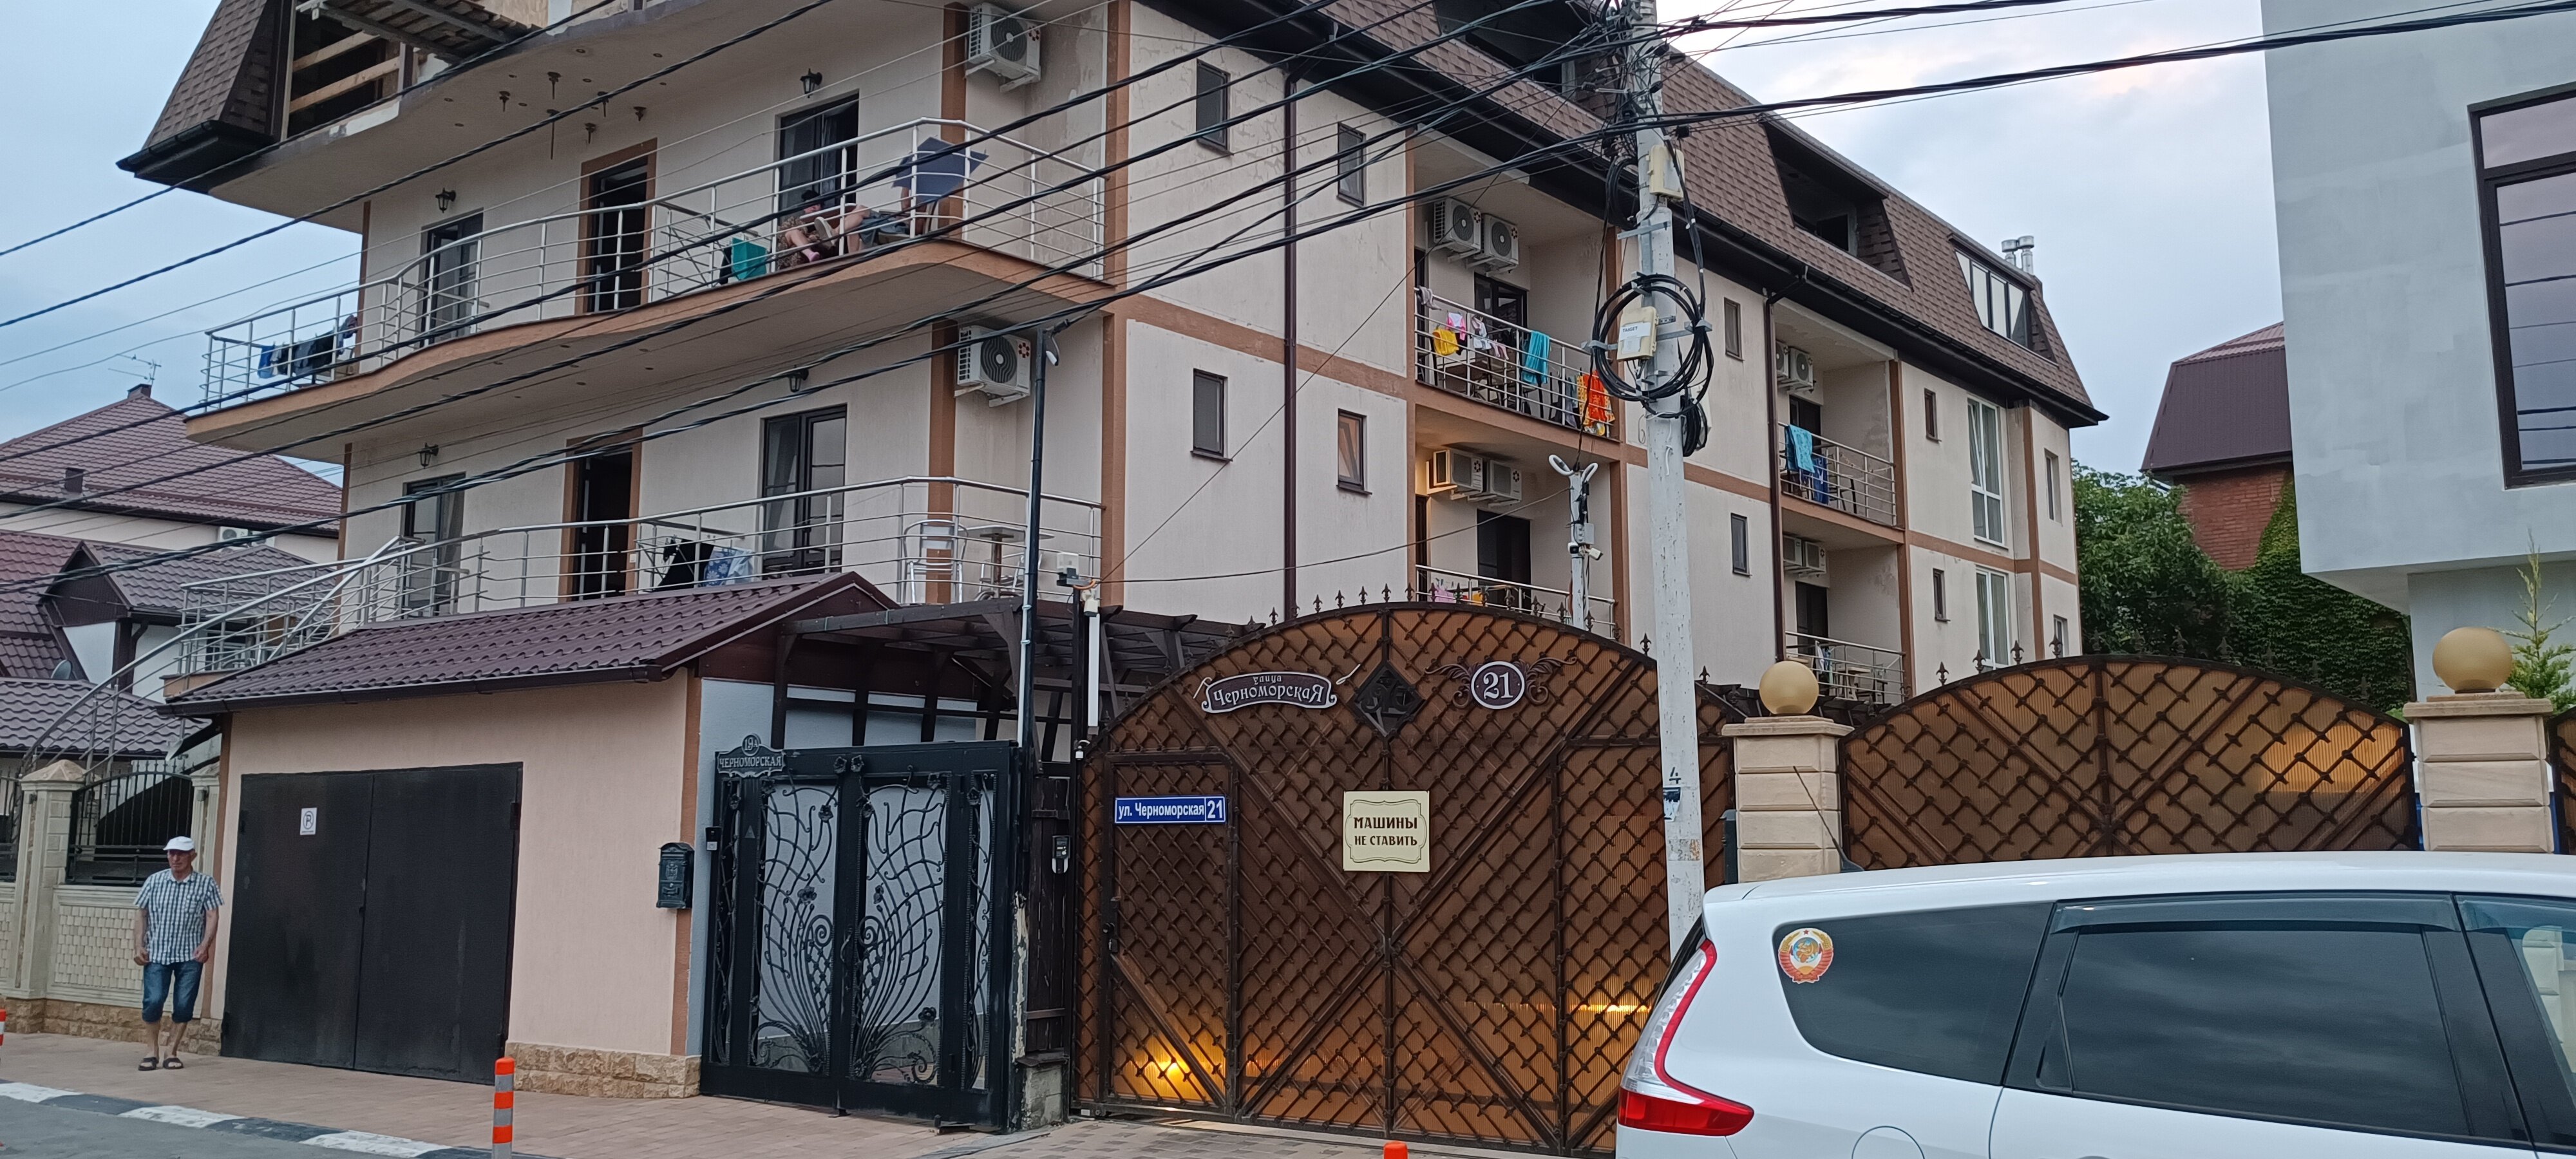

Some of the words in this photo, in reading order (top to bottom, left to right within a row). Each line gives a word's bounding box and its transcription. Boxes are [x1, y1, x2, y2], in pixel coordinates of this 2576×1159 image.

[1253, 675, 1282, 685] улица
[1482, 672, 1513, 700] 21
[719, 756, 782, 768] ЧЕРНОМОРСКАЯ
[1118, 806, 1133, 820] ул.
[1135, 802, 1204, 819] Черноморская
[1207, 800, 1223, 819] 21
[1353, 816, 1417, 829] МАШИНЫ
[1354, 835, 1367, 845] НЕ
[1369, 835, 1418, 846] СТАВИТЬ
